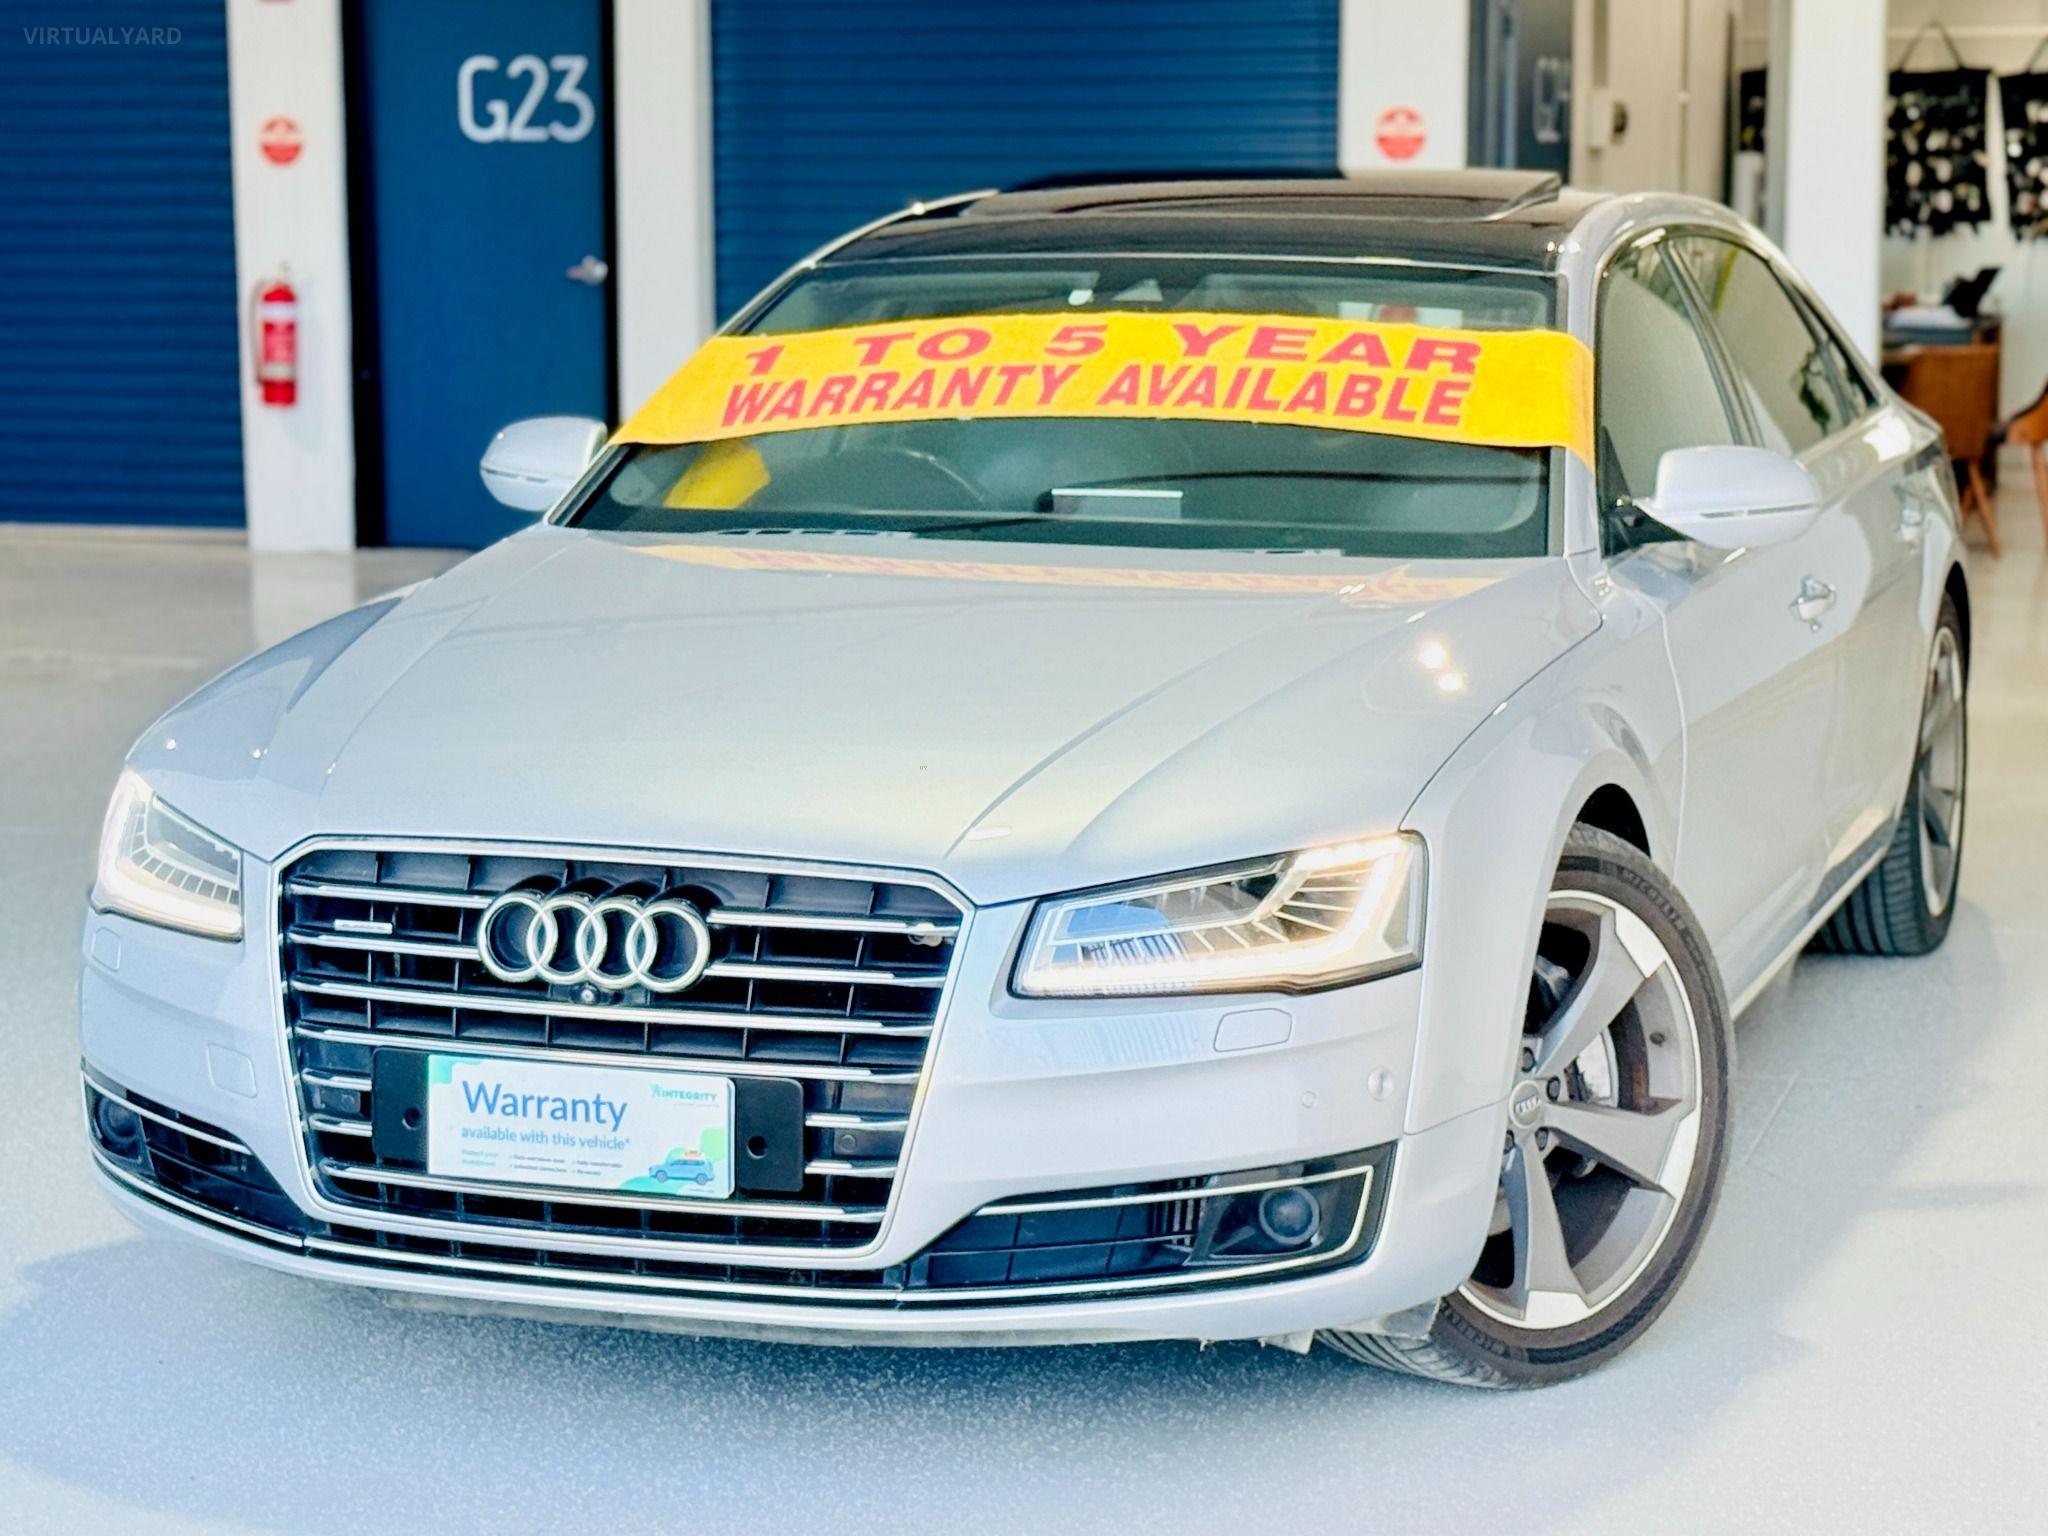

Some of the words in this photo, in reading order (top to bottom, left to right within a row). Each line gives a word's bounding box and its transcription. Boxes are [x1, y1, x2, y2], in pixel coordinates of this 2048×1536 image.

[457, 54, 595, 143] G23
[747, 345, 785, 376] 1
[853, 327, 992, 367] TO
[1044, 325, 1108, 357] 5
[1173, 323, 1482, 375] YEAR
[721, 364, 1082, 428] WARRANTY
[1096, 364, 1471, 426] AVAILABLE
[462, 1080, 628, 1132] Warranty
[661, 1089, 718, 1101] INTEGRITY
[461, 1127, 517, 1142] available
[520, 1131, 549, 1145] with
[552, 1132, 576, 1147] this
